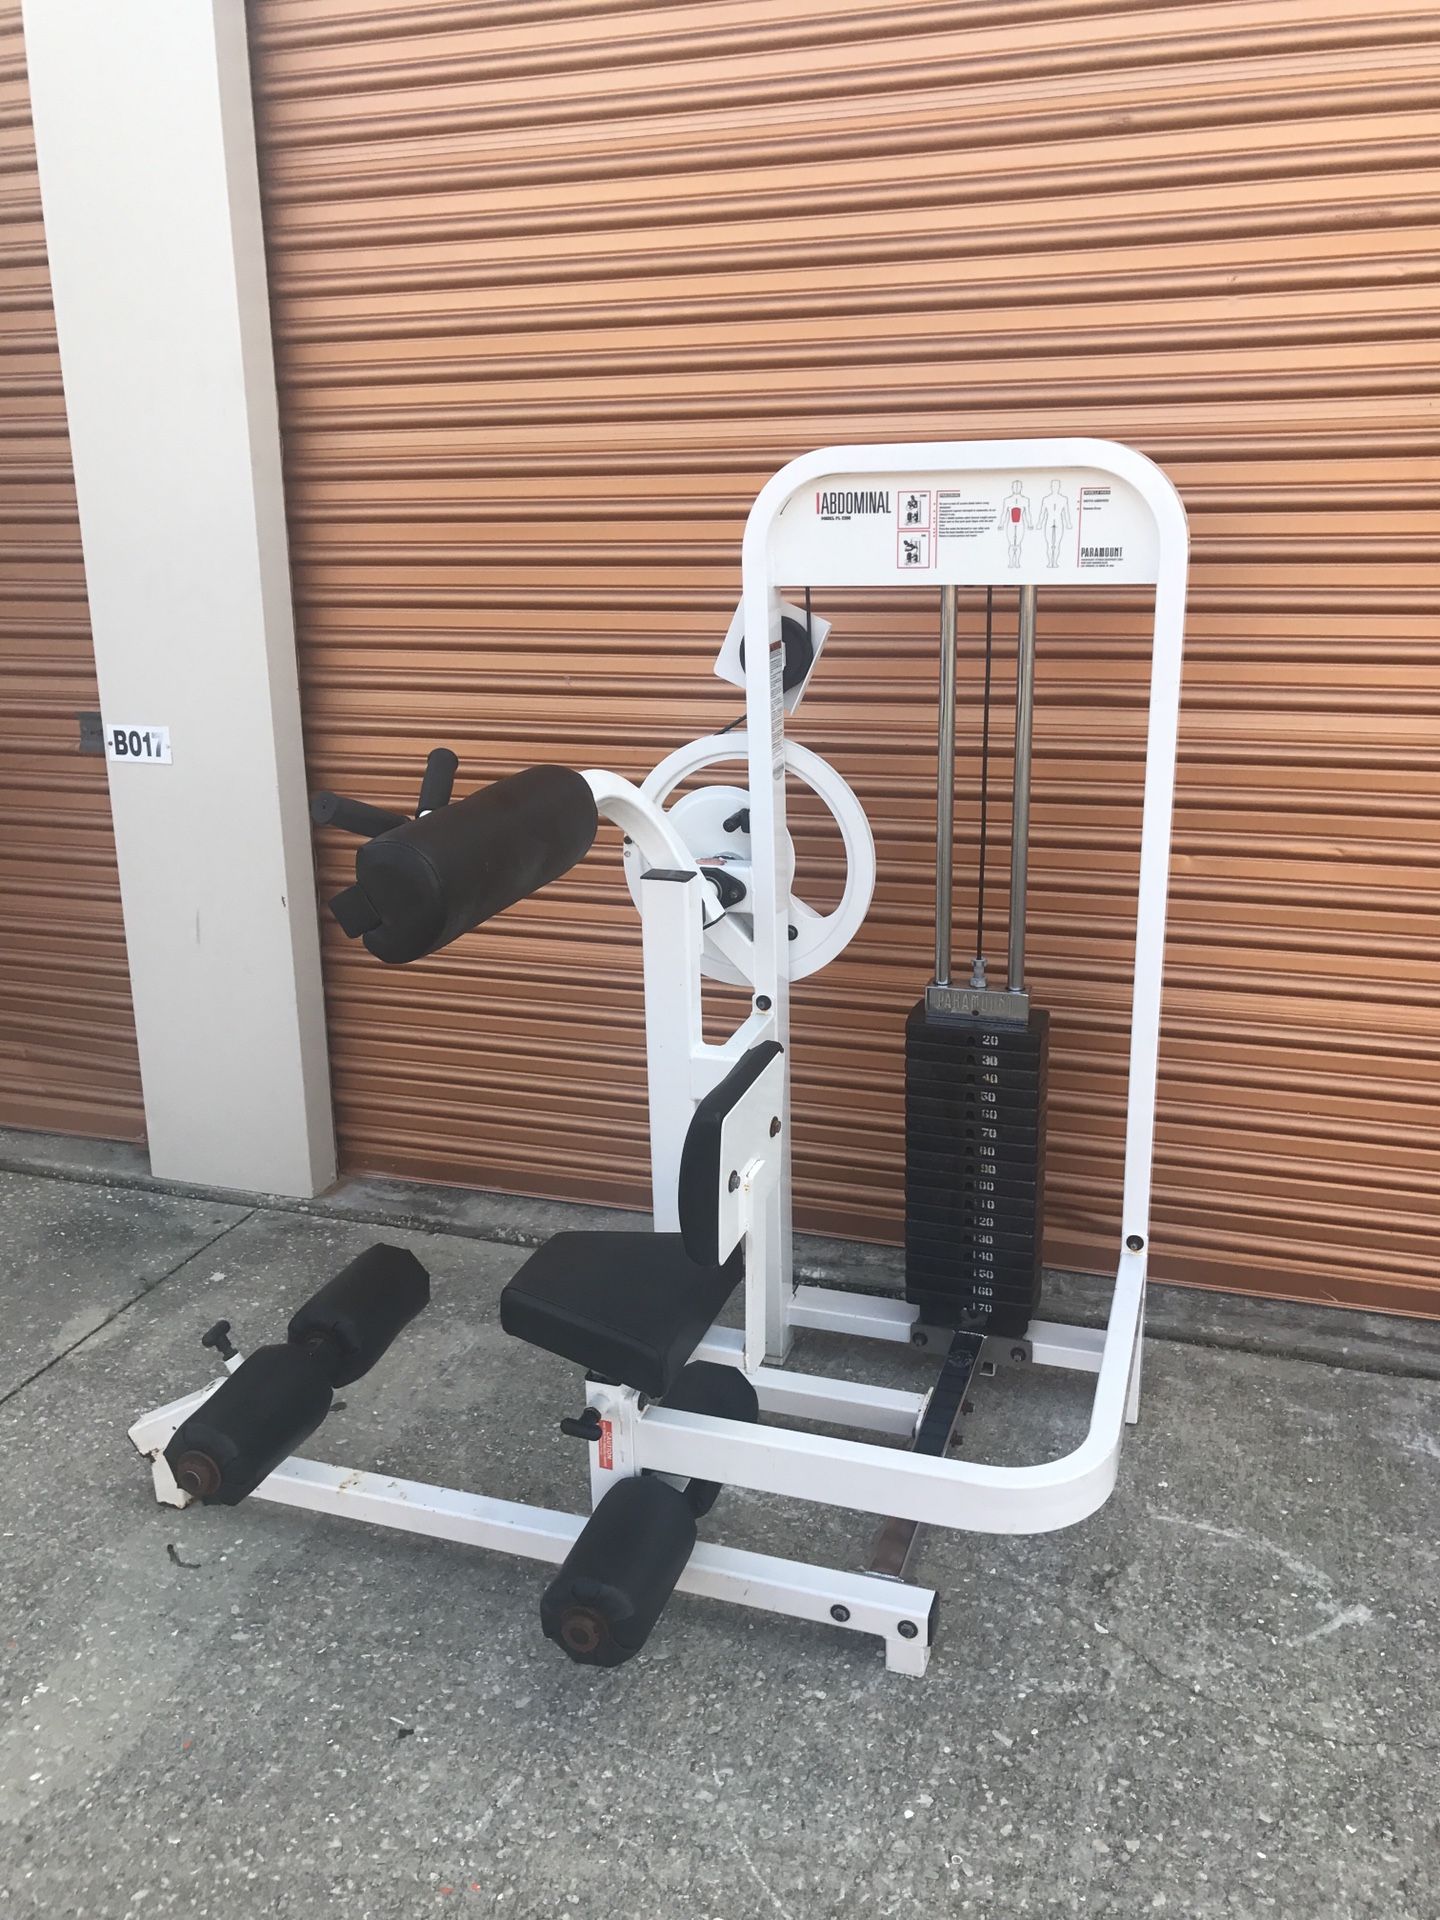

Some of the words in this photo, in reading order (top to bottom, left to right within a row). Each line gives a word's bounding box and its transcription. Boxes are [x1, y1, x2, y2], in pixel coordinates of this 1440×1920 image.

[820, 491, 892, 514] ABDOMINAL
[1081, 547, 1123, 557] PARAMOUNT
[113, 730, 162, 757] B017
[982, 1035, 998, 1046] 20
[982, 1055, 998, 1066] 30
[981, 1091, 996, 1102] 50
[982, 1109, 997, 1119] 60
[981, 1127, 997, 1138] 70
[981, 1164, 996, 1174] 90
[973, 1302, 993, 1313] 170
